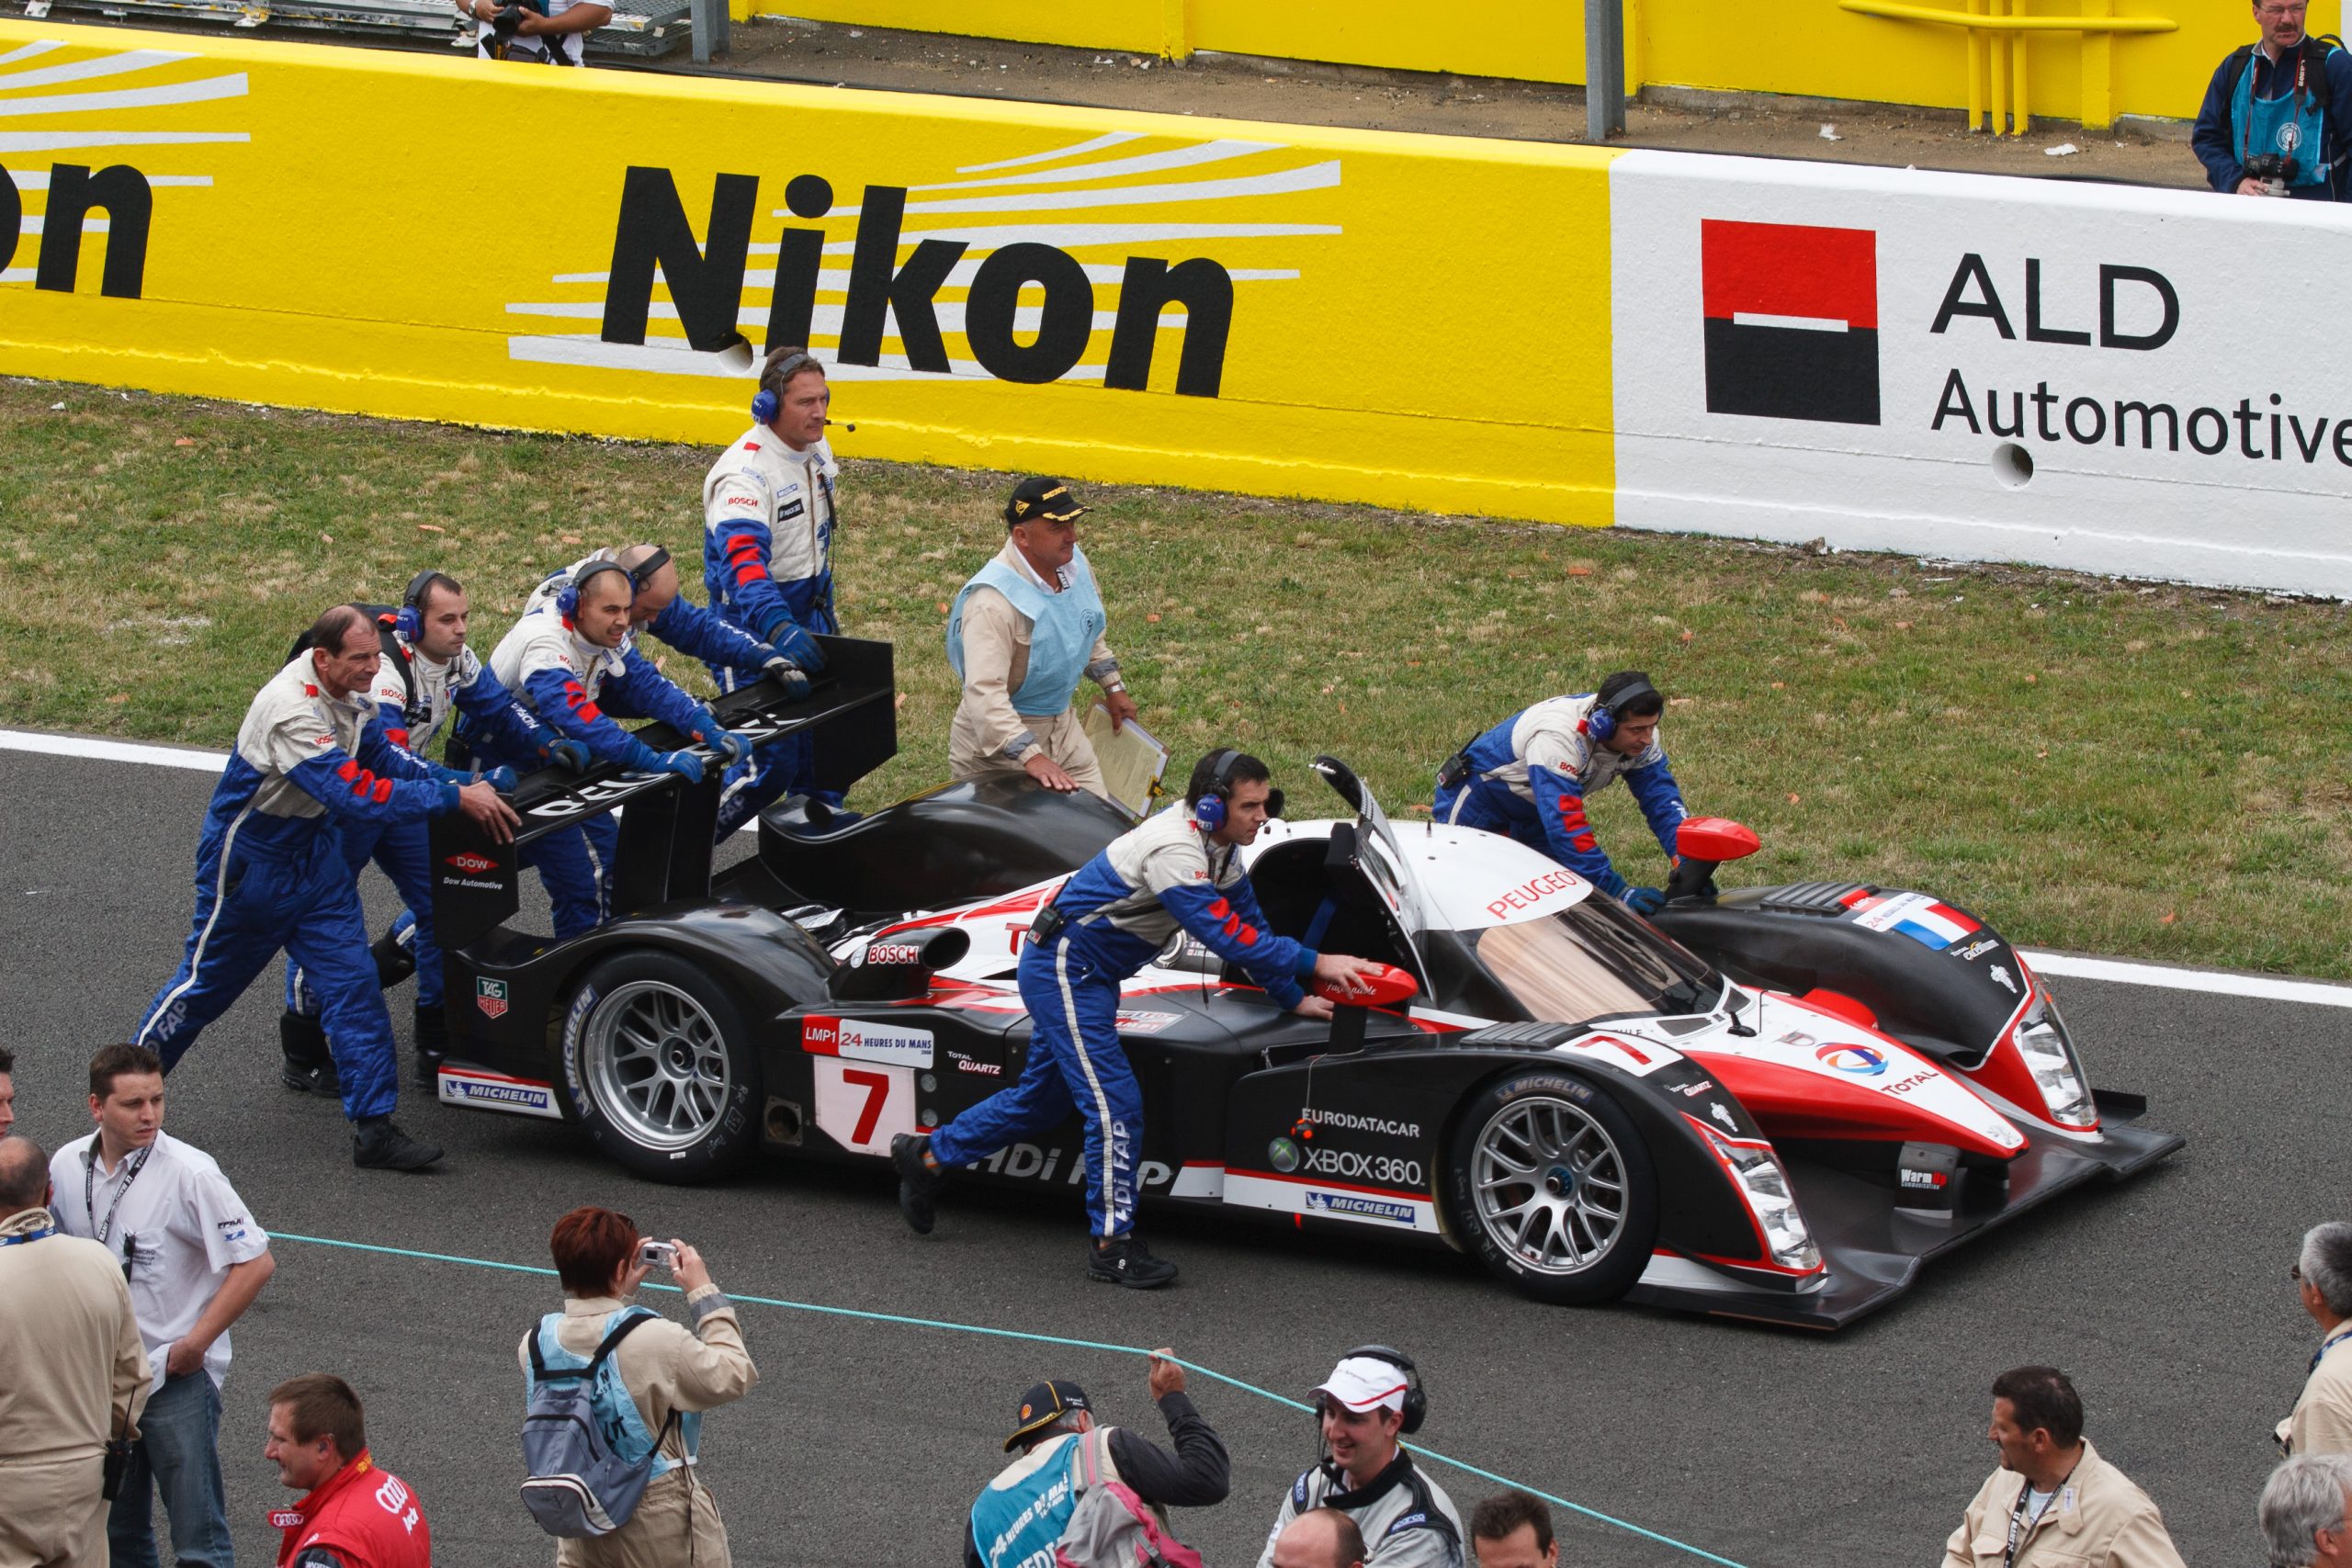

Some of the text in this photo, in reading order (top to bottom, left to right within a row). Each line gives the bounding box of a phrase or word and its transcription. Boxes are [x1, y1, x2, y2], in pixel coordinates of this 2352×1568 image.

[2298, 59, 2306, 87] Canon
[602, 165, 1234, 398] Nikon
[1929, 253, 2180, 351] ALD
[728, 497, 759, 508] BOSCH
[380, 688, 408, 705] BOSCH
[443, 876, 503, 890] Dow Automotive
[1866, 917, 1885, 929] 24
[867, 944, 919, 964] BOSCH
[481, 980, 503, 998] TAG
[479, 998, 506, 1017] HEUER
[156, 1000, 187, 1043] FAP
[562, 987, 594, 1089] MICHELIN
[805, 1026, 932, 1050] LMP1 24 HEURES DU MANS
[947, 1050, 972, 1061] TOTAL
[1574, 1035, 1652, 1066] 7
[958, 1060, 1001, 1076] QUARTZ
[469, 1085, 546, 1105] MICHELIN
[1514, 1077, 1590, 1100] MICHELIN
[1880, 1070, 1940, 1096] TOTAL
[842, 1068, 889, 1145] 7
[1301, 1107, 1420, 1138] EURODATACAR
[1112, 1119, 1133, 1223] HDi FAP
[1331, 1197, 1413, 1219] MICHELIN
[1004, 1506, 1035, 1546] HEURES
[2007, 1511, 2022, 1544] LE MANS
